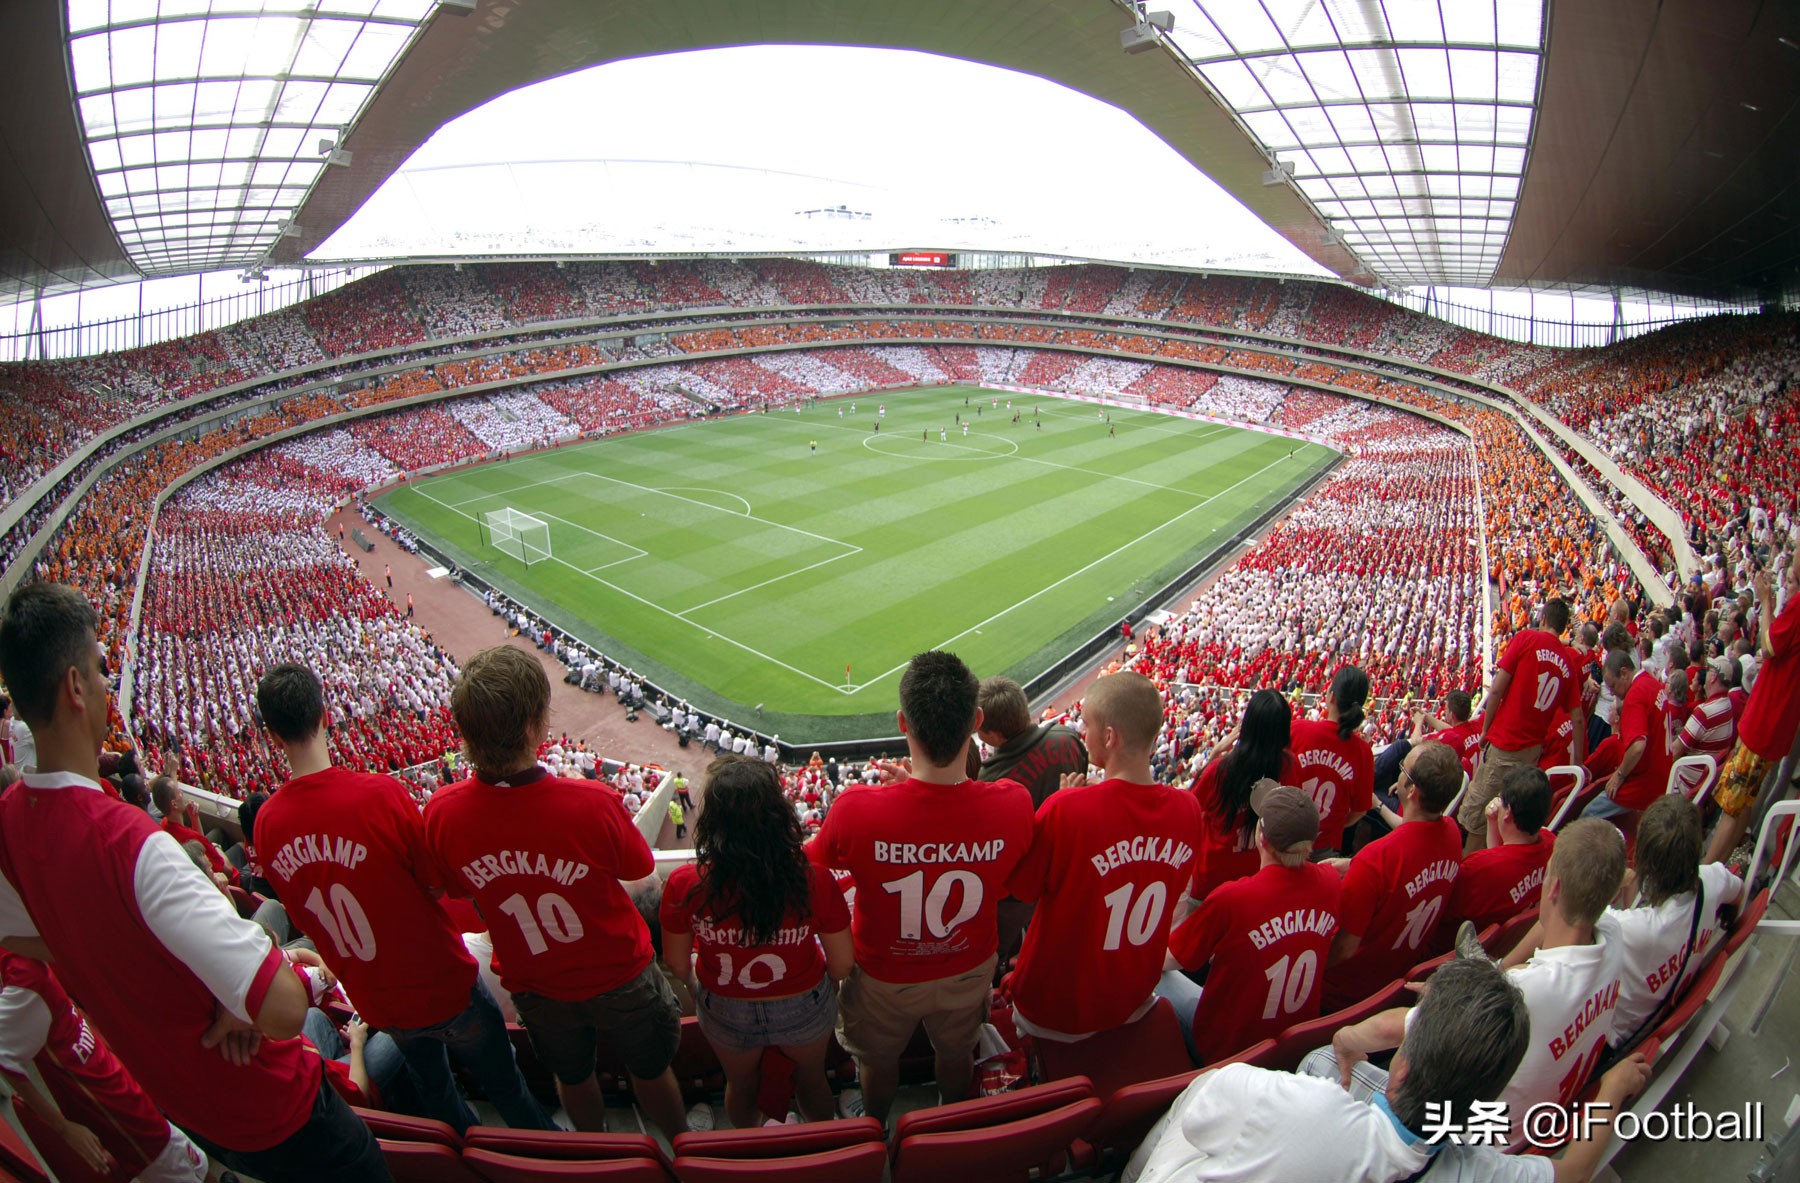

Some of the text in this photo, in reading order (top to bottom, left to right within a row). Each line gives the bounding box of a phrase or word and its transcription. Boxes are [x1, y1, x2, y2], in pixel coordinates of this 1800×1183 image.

[1534, 671, 1560, 712] 10
[1298, 749, 1354, 780] BERGKAMP
[271, 834, 368, 882] BERGKAMP
[461, 850, 589, 889] BERGKAMP
[874, 839, 1005, 864] BERGKAMP
[1091, 835, 1193, 877] BERGKAMP
[304, 883, 377, 962] 10
[498, 892, 585, 956] 10
[881, 869, 984, 941] 10
[1103, 881, 1167, 950] 10
[1391, 895, 1443, 951] 10
[1248, 908, 1336, 950] BERGKAMP
[715, 953, 787, 990] 10
[1262, 949, 1318, 1020] 10
